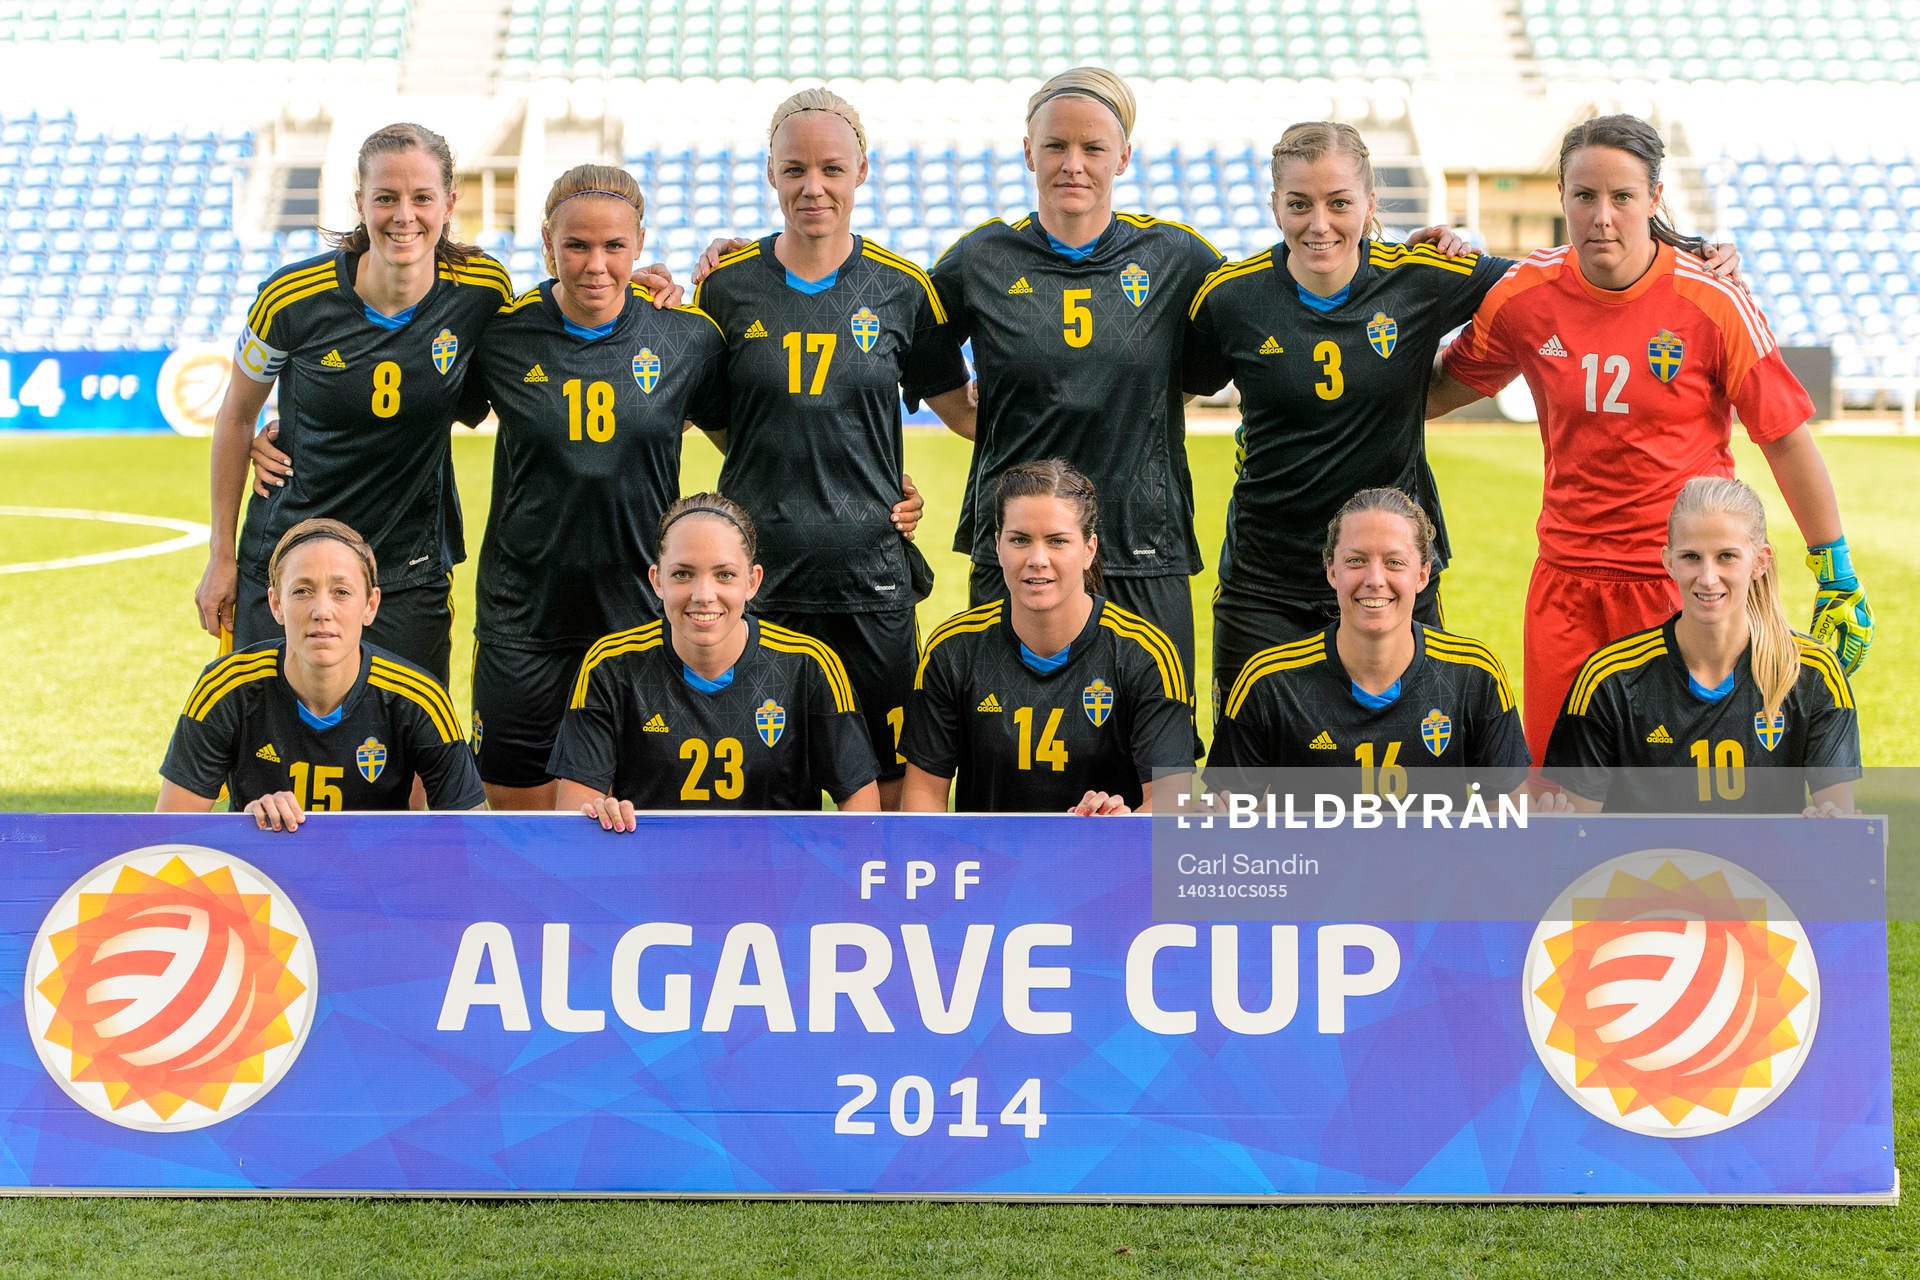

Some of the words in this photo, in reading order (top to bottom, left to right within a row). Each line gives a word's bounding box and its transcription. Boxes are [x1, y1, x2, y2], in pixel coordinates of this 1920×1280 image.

[1008, 287, 1033, 295] adidas
[744, 330, 769, 339] adidas
[1063, 288, 1093, 348] 5
[243, 339, 267, 372] C
[320, 359, 346, 369] adidas
[782, 331, 837, 395] 17
[1259, 346, 1284, 355] adidas
[1313, 340, 1344, 400] 3
[1538, 347, 1568, 358] adidas
[371, 360, 402, 418] 8
[523, 375, 549, 383] adidas
[1581, 353, 1630, 414] 12
[562, 378, 616, 443] 18
[1817, 614, 1835, 640] sport
[642, 724, 670, 733] adidas
[976, 704, 1003, 713] adidas
[255, 750, 281, 763] adidas
[1013, 706, 1068, 772] 14
[1308, 742, 1337, 750] adidas
[1646, 736, 1673, 744] adidas
[289, 761, 344, 812] 15
[679, 737, 745, 801] 23
[1354, 741, 1408, 804] 16
[1690, 739, 1746, 801] 10
[860, 860, 981, 900] FPF
[436, 921, 1074, 1035] ALGARVE
[1125, 922, 1401, 1036] CUP
[833, 1073, 1048, 1139] 2014
